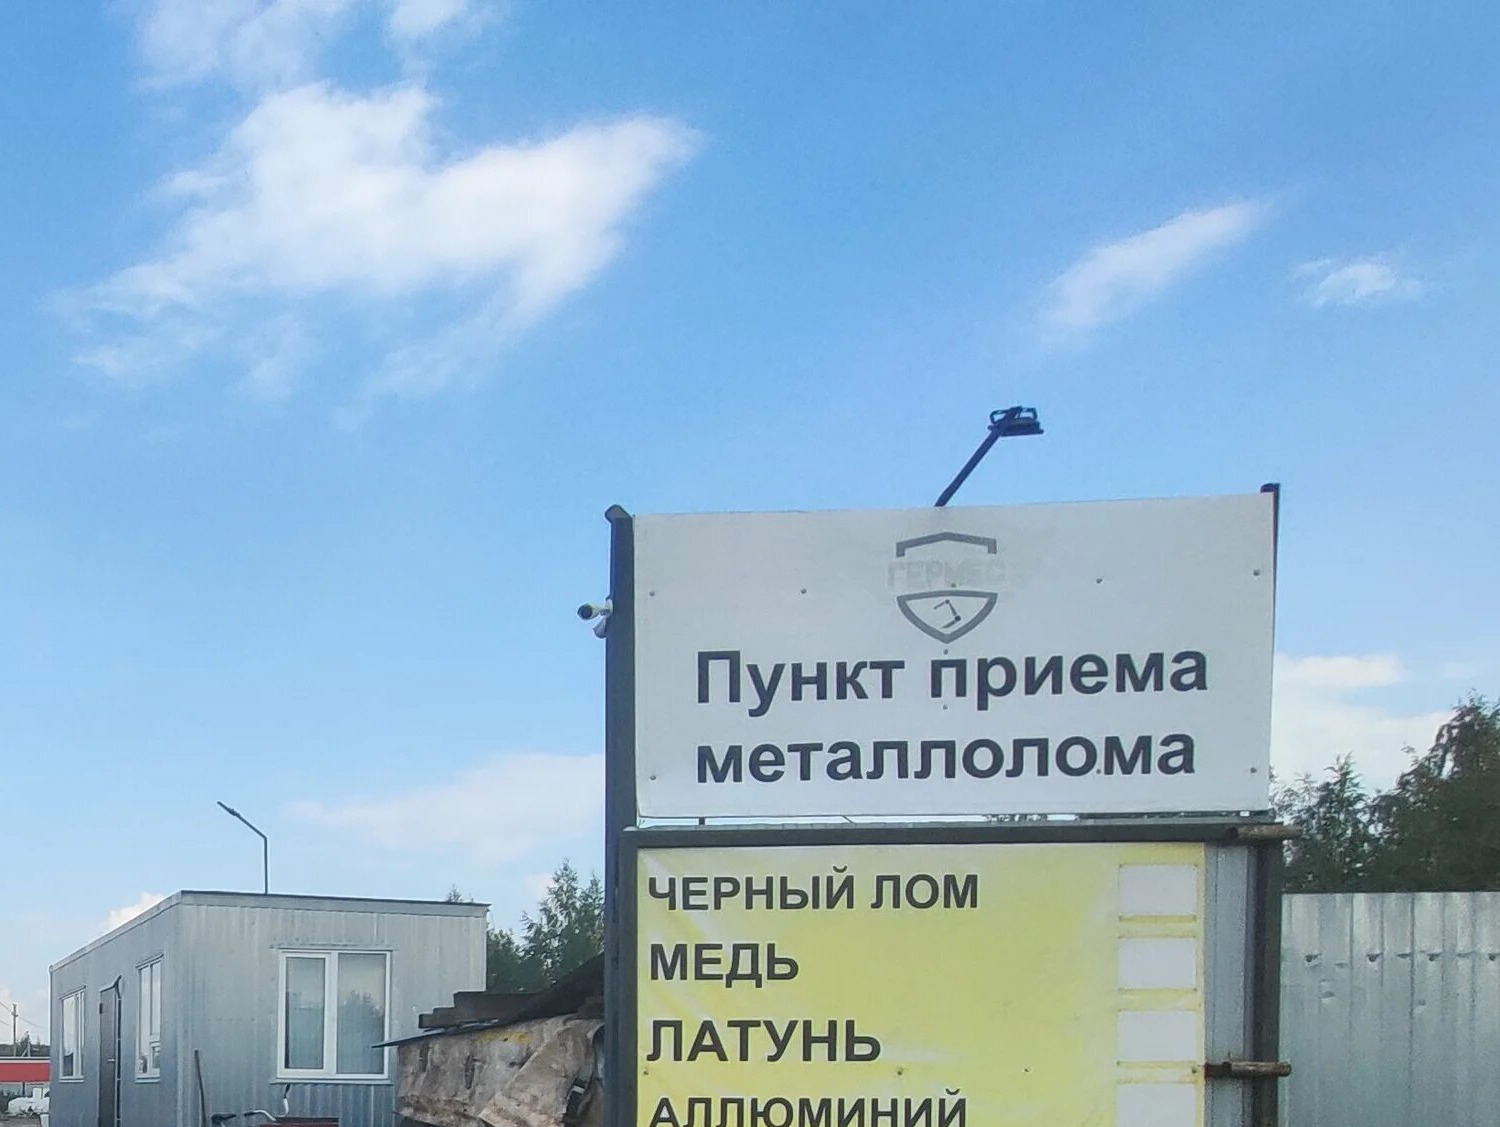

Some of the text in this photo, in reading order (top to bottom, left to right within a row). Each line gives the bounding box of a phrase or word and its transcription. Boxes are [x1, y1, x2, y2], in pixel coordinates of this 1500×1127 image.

[697, 650, 1208, 717] Пункт приема
[696, 733, 1195, 784] металлолома
[648, 866, 979, 911] ЧЕРНЫЙ ЛОМ
[650, 943, 799, 988] МЕДЬ
[646, 1019, 881, 1063] ЛАТУНЬ
